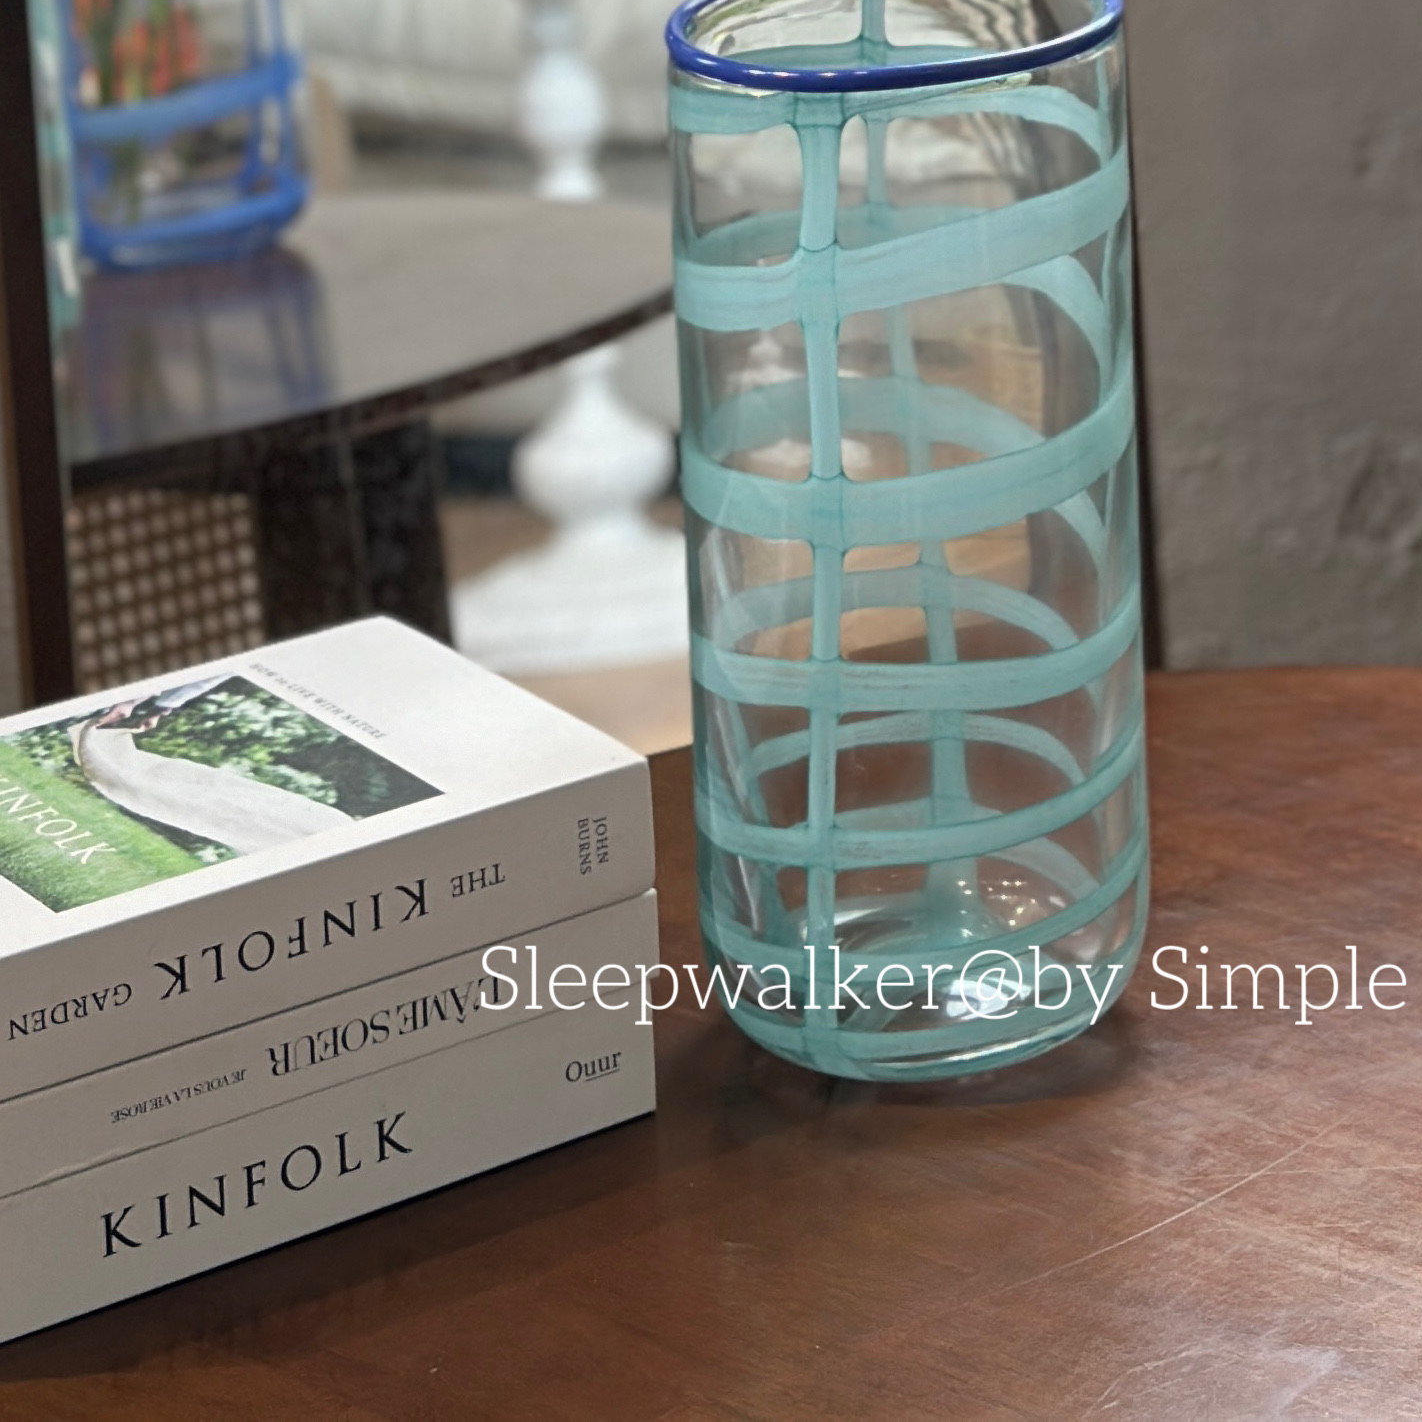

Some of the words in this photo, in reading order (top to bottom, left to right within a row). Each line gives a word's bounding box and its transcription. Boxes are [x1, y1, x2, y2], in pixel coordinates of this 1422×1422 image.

[287, 683, 317, 699] LIVE
[314, 696, 345, 715] WITH
[342, 713, 389, 739] NATURE
[0, 777, 117, 865] INFOLK
[577, 818, 592, 875] BURNS
[591, 816, 609, 864] JOHN
[450, 862, 506, 898] THE
[154, 878, 430, 1001] KINFOLK
[8, 982, 133, 1041] GARDEN
[265, 1009, 391, 1077] SOEUR
[565, 1051, 622, 1082] Ouur
[110, 1101, 148, 1124] ROSE
[174, 1086, 192, 1103] LA
[100, 1111, 413, 1258] KINFOLK
